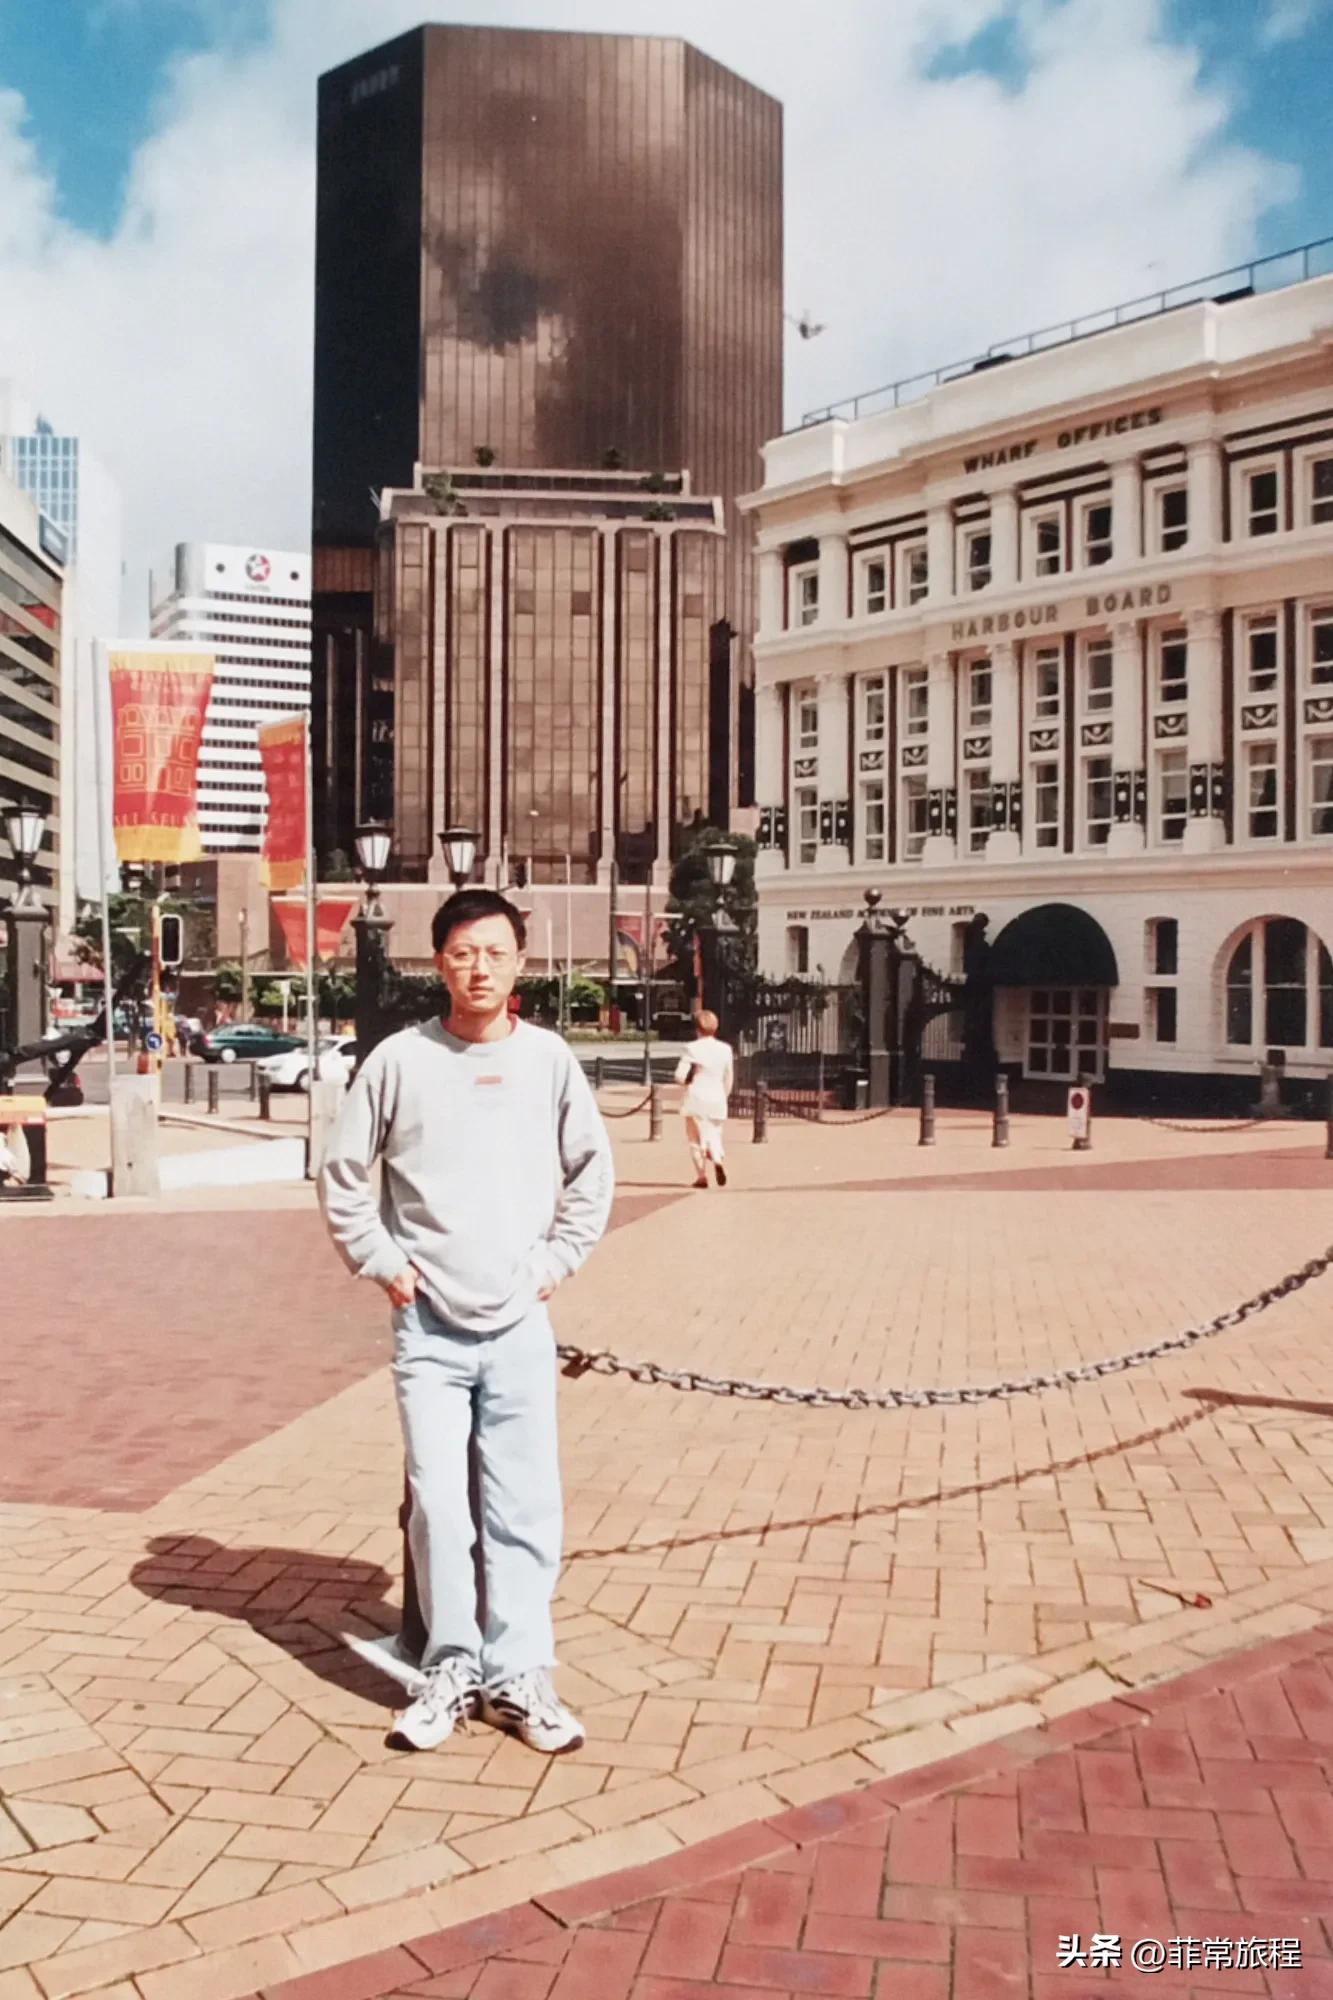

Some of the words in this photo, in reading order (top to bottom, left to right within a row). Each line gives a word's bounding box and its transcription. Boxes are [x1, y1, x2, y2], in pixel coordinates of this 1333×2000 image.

[963, 438, 1039, 475] WHARF
[1056, 407, 1163, 449] OFFICES
[951, 604, 1059, 641] HARBOUR
[1086, 584, 1172, 617] BOARD
[787, 910, 807, 920] NEW
[810, 909, 854, 920] ZEALAND
[922, 906, 944, 917] FINE
[949, 905, 975, 916] ARTS
